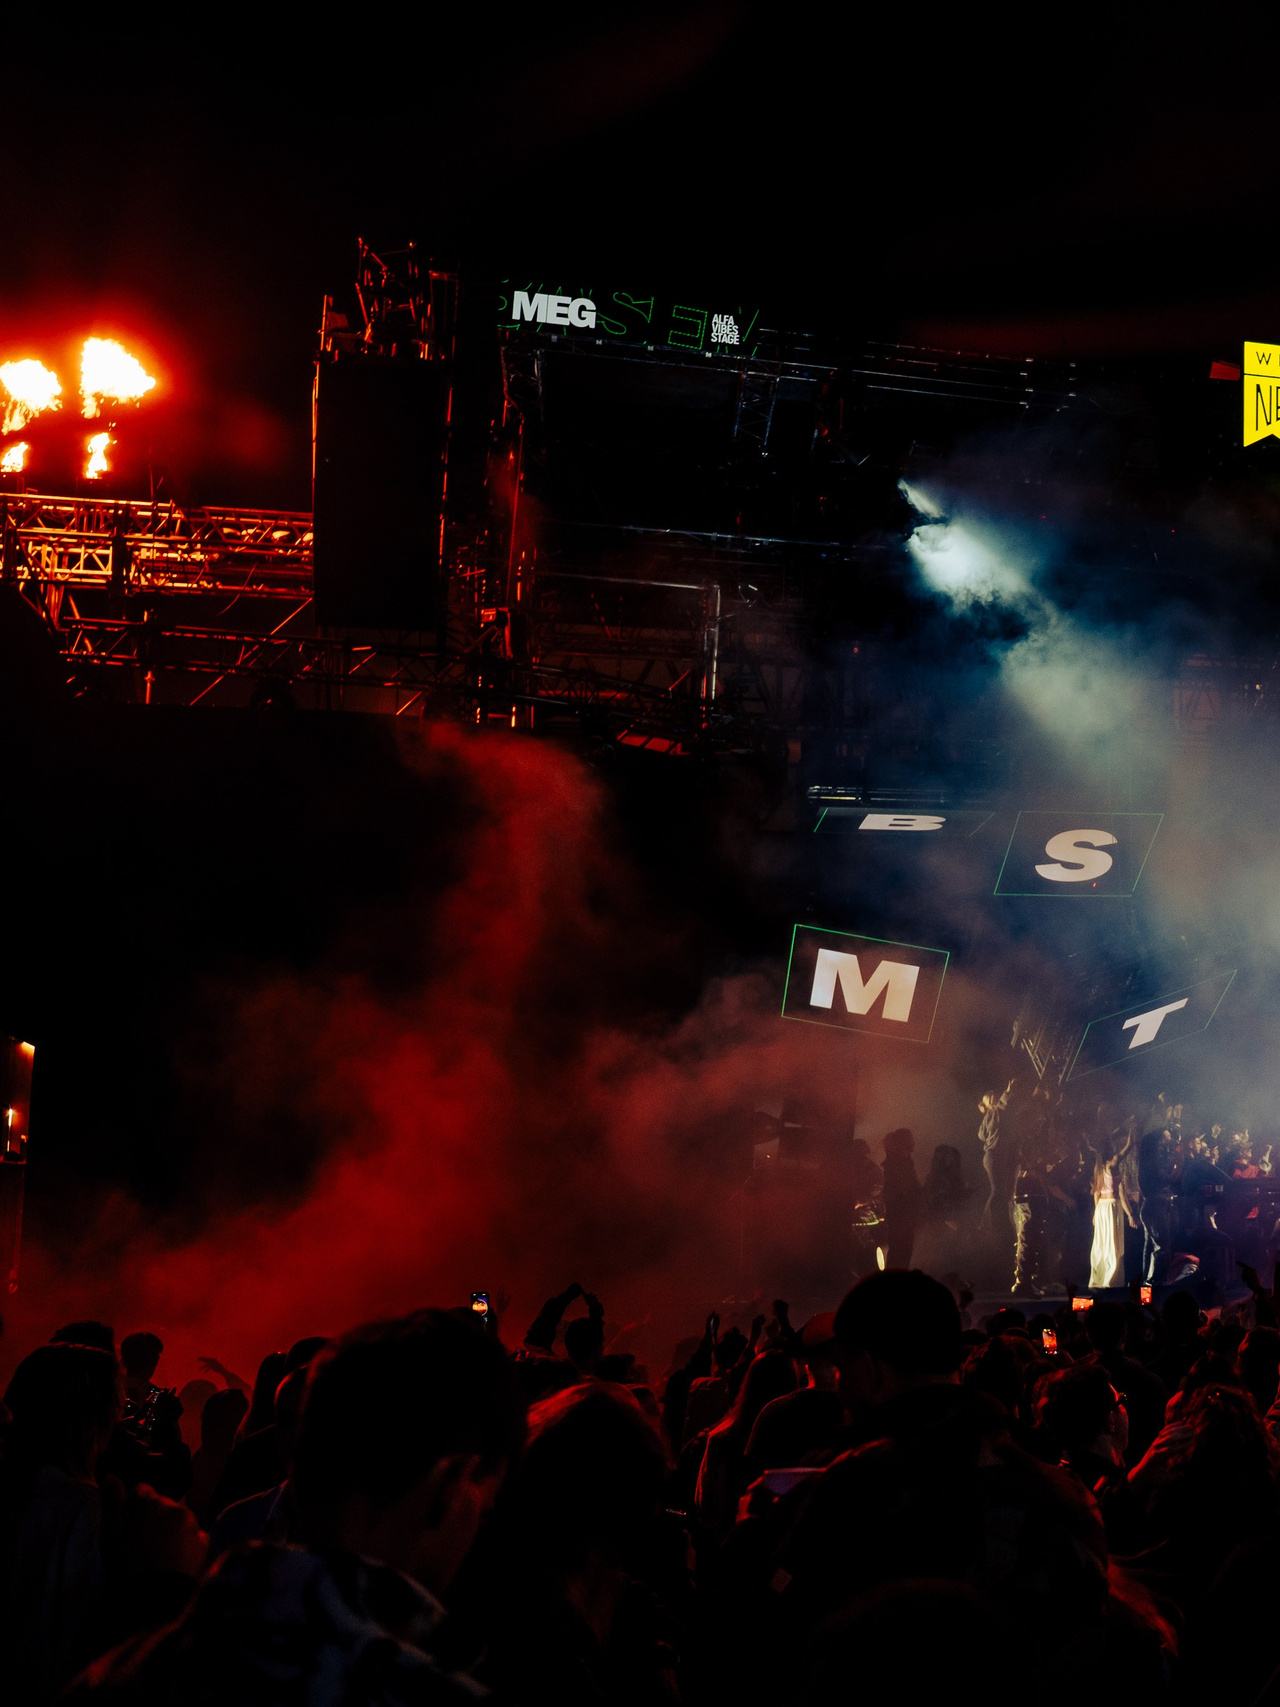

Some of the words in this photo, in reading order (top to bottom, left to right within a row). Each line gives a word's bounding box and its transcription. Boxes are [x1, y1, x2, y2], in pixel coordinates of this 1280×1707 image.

[512, 290, 597, 329] MEG
[712, 313, 735, 326] ALFA
[710, 332, 740, 345] STAGE
[711, 322, 739, 335] VIBES
[857, 813, 947, 831] B
[1034, 829, 1119, 883] S
[809, 948, 920, 1023] M
[1122, 997, 1190, 1050] T
